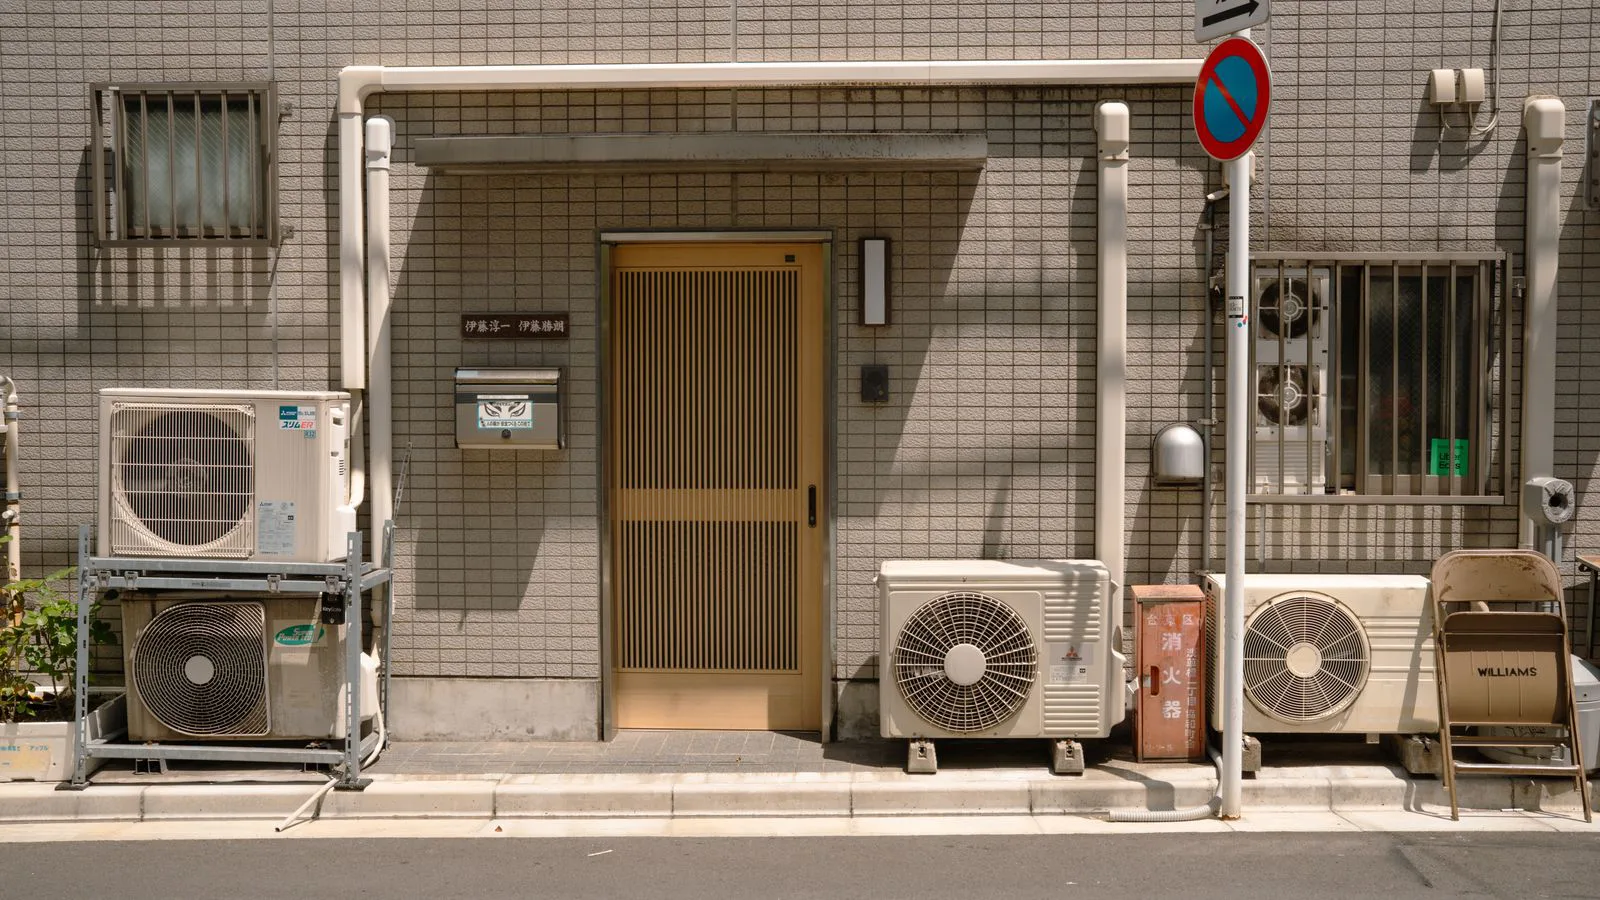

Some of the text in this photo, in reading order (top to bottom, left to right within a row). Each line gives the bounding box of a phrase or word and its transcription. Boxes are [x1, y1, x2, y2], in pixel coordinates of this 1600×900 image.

[1161, 632, 1182, 719] 消火器
[1477, 666, 1537, 677] WILLIAMS
